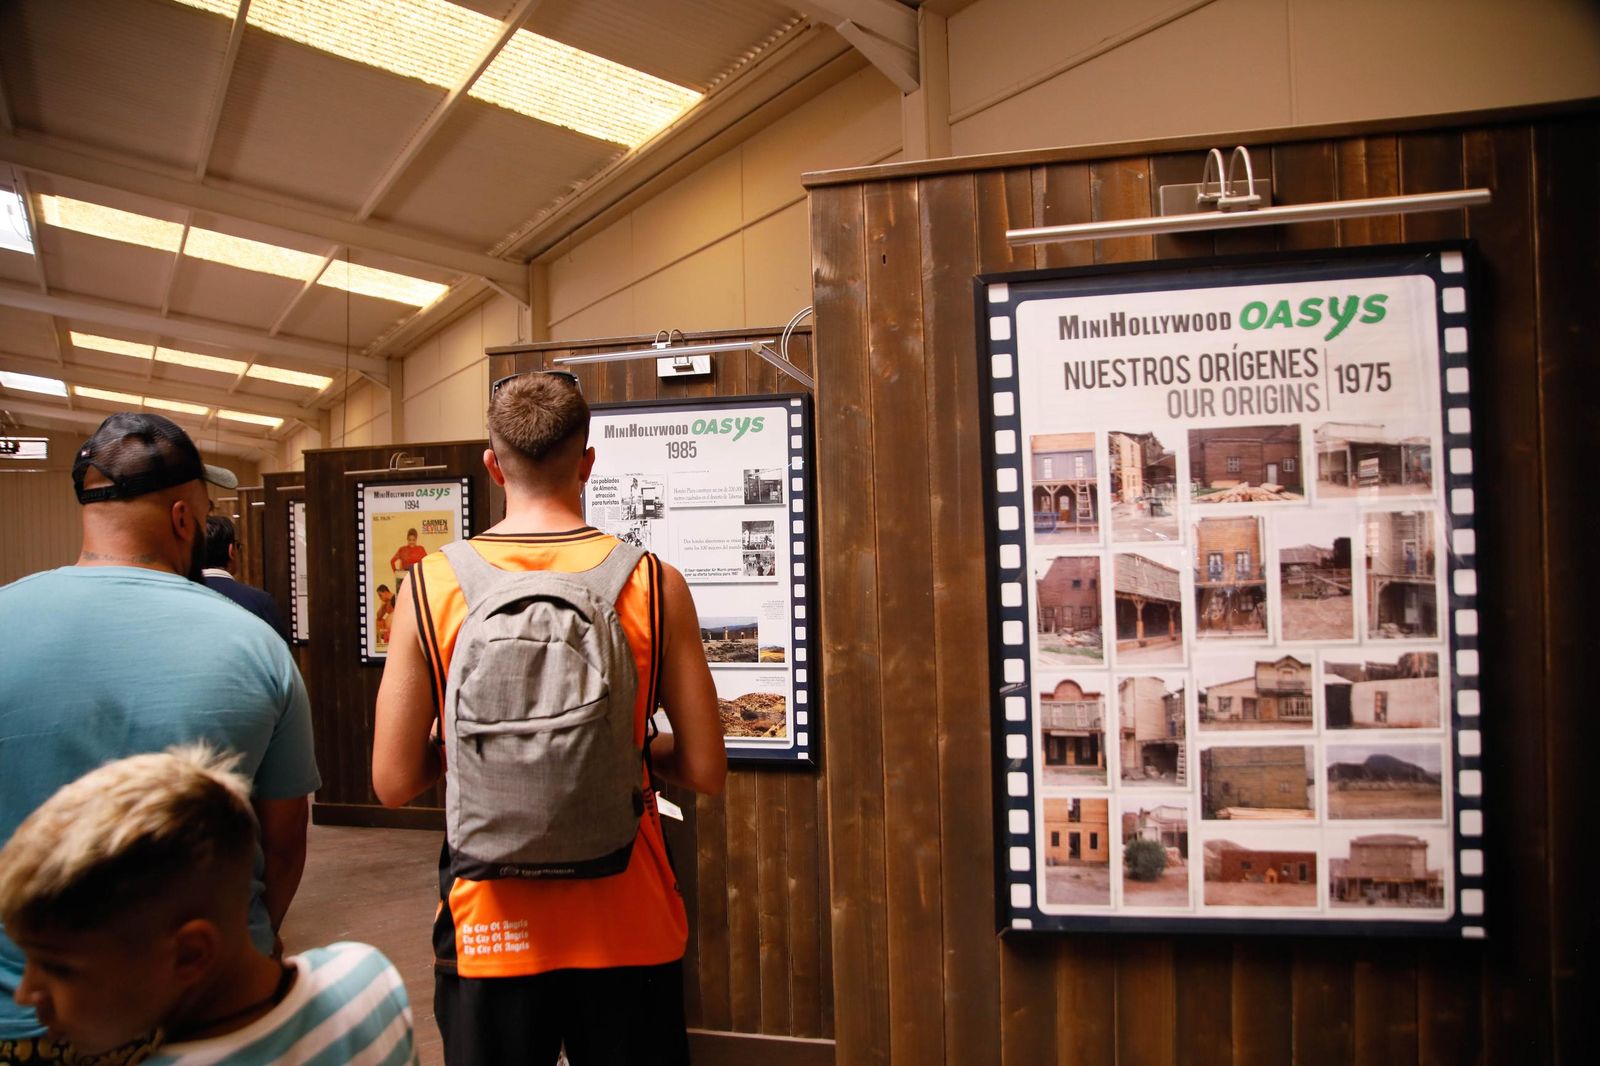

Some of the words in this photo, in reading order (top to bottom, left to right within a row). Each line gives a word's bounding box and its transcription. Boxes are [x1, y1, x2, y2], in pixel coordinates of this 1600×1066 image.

[1064, 355, 1191, 390] NUESTROS
[1200, 343, 1319, 382] ORÍGENES
[1334, 362, 1392, 394] 1975
[1167, 388, 1216, 419] OUR
[1222, 383, 1321, 416] ORIGINS
[666, 441, 697, 459] 1985
[404, 500, 420, 510] 1994
